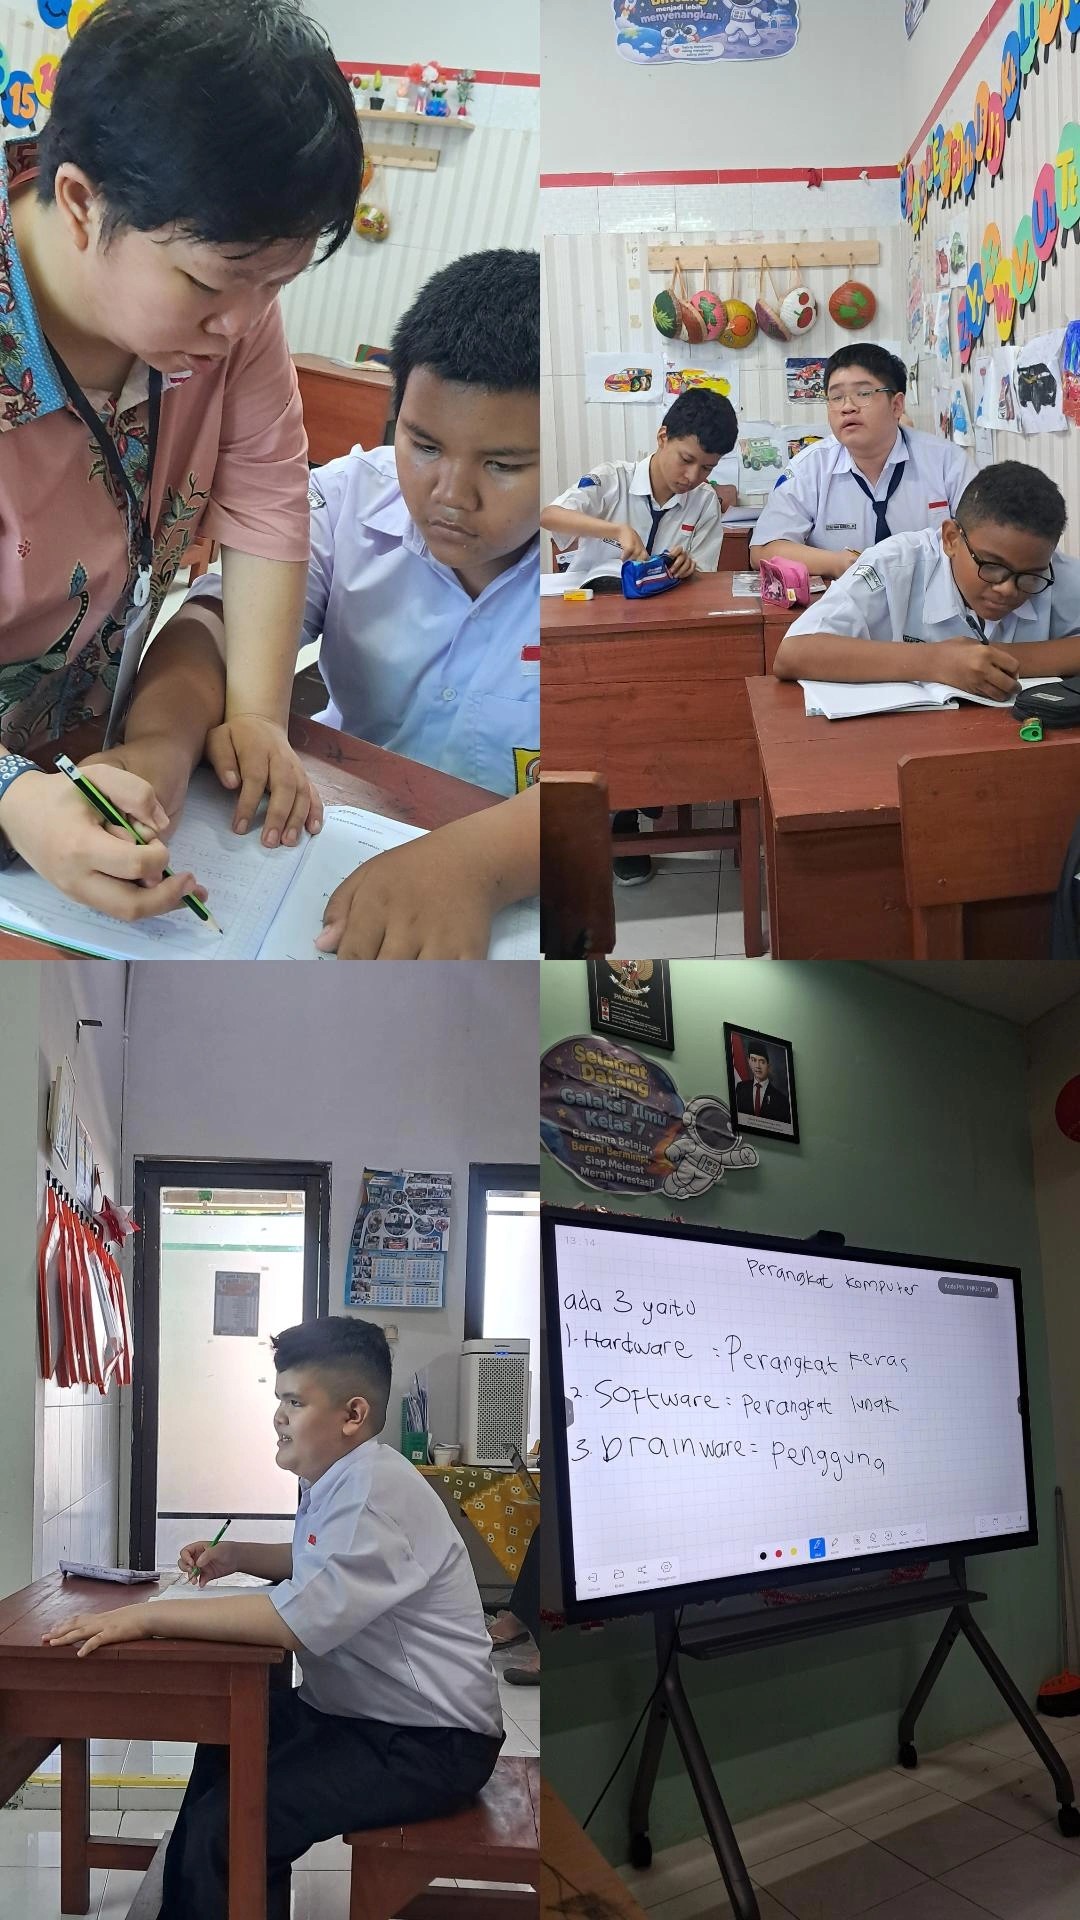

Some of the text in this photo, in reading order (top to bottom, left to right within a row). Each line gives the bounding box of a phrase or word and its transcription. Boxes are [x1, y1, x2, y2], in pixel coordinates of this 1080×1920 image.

[640, 10, 722, 23] menyenangkan.
[656, 4, 684, 13] menjadi
[686, 3, 703, 11] lebih
[9, 81, 36, 119] 15
[1055, 148, 1079, 211] Tt
[1032, 188, 1057, 248] Uu
[966, 278, 983, 326] Yy
[573, 1043, 649, 1080] Selamat
[580, 1063, 649, 1098] Datang
[560, 1088, 667, 1127] Galaksi Ilmu
[585, 1110, 646, 1135] Kelas 7
[571, 1141, 605, 1154] Berani
[572, 1129, 616, 1145] Bersama
[580, 1166, 655, 1188] Meraih Prestasi!
[585, 1155, 645, 1174] Siap Melesat
[563, 1289, 696, 1326] ada 3 yaitu
[849, 1394, 900, 1414] lunak
